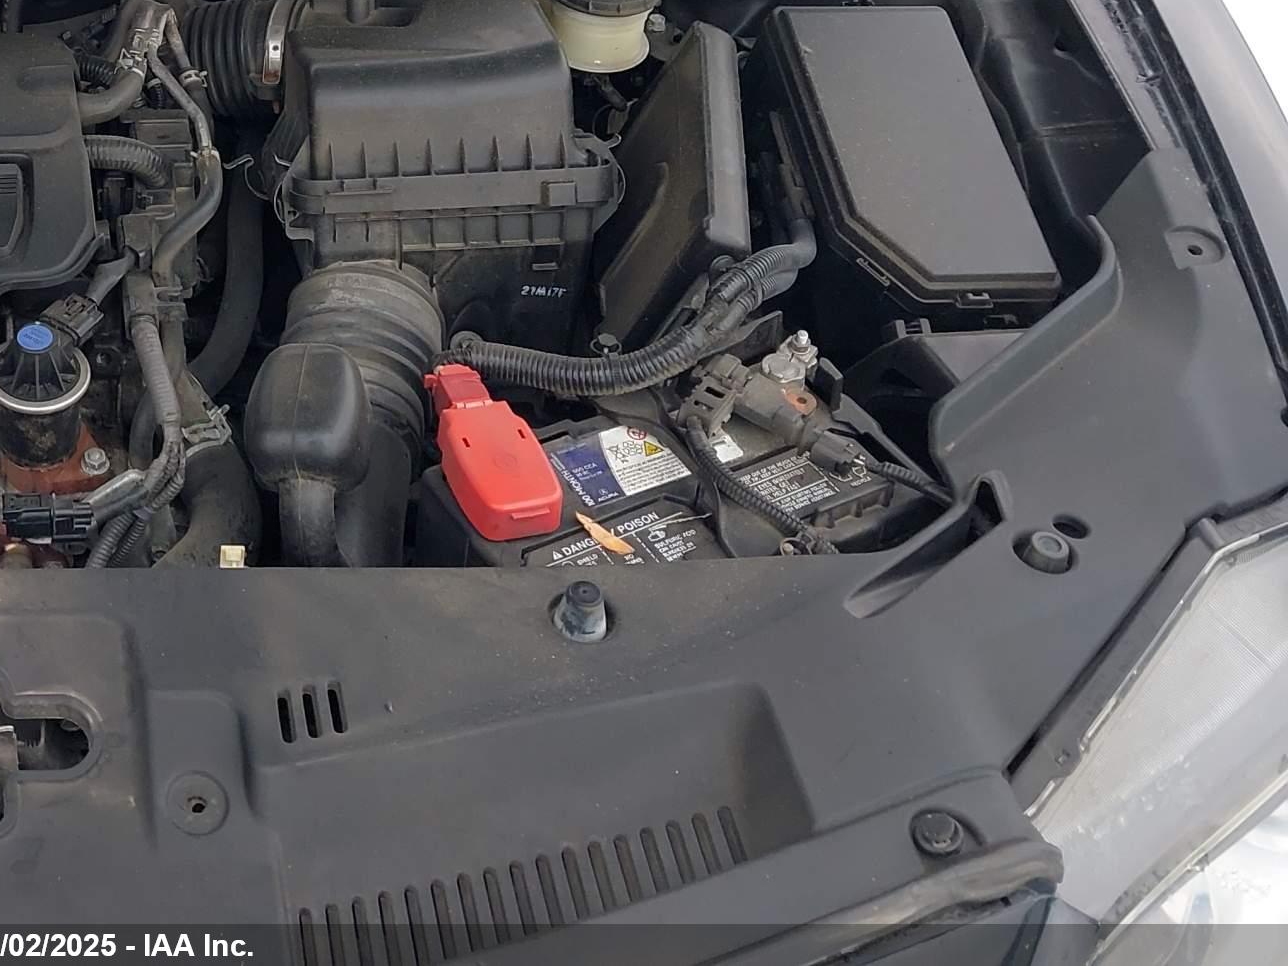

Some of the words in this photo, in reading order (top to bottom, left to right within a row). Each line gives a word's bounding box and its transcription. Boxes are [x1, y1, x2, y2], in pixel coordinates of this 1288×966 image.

[561, 469, 587, 496] MONTH
[598, 491, 620, 503] ACURA
[616, 512, 660, 534] POISON
